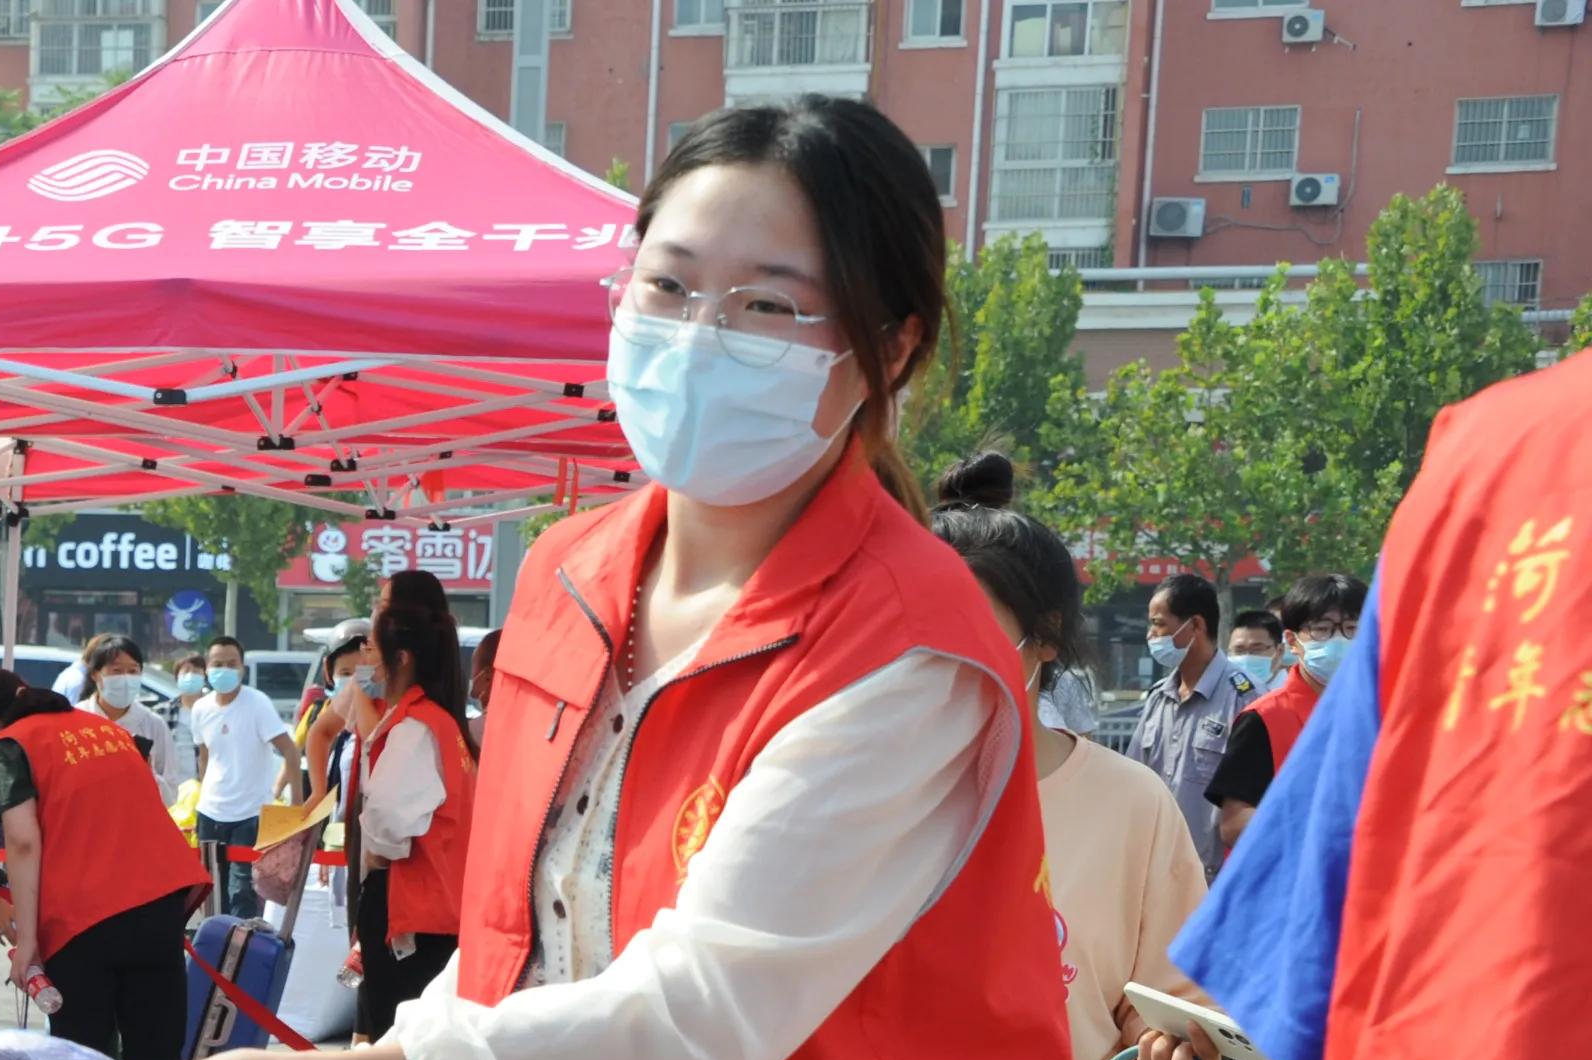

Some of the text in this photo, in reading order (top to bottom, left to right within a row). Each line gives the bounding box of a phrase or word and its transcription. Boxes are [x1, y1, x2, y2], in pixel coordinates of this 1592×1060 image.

[175, 141, 422, 173] 中国移动
[168, 173, 414, 192] China Mobile
[57, 531, 178, 570] coffee
